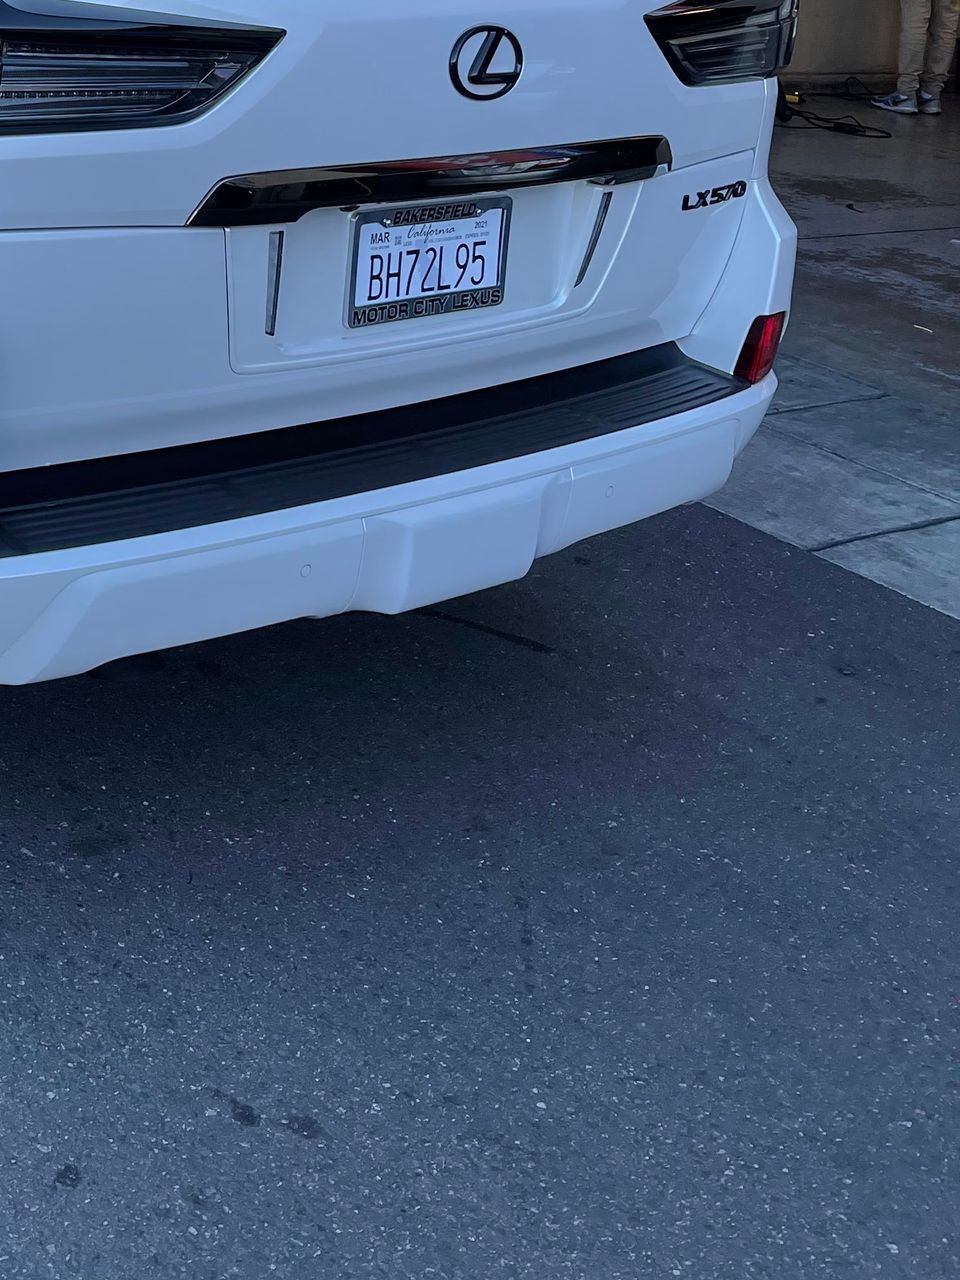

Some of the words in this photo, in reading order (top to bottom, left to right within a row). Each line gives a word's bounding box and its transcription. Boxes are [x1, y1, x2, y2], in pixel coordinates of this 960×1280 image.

[393, 203, 477, 225] BAKERSFIELD
[370, 232, 390, 245] MAR
[407, 224, 455, 244] California
[474, 220, 488, 229] 2021
[368, 240, 487, 302] BH72L95
[352, 303, 409, 326] MOTOR
[414, 296, 449, 316] CITY
[452, 289, 501, 310] LEXUS
